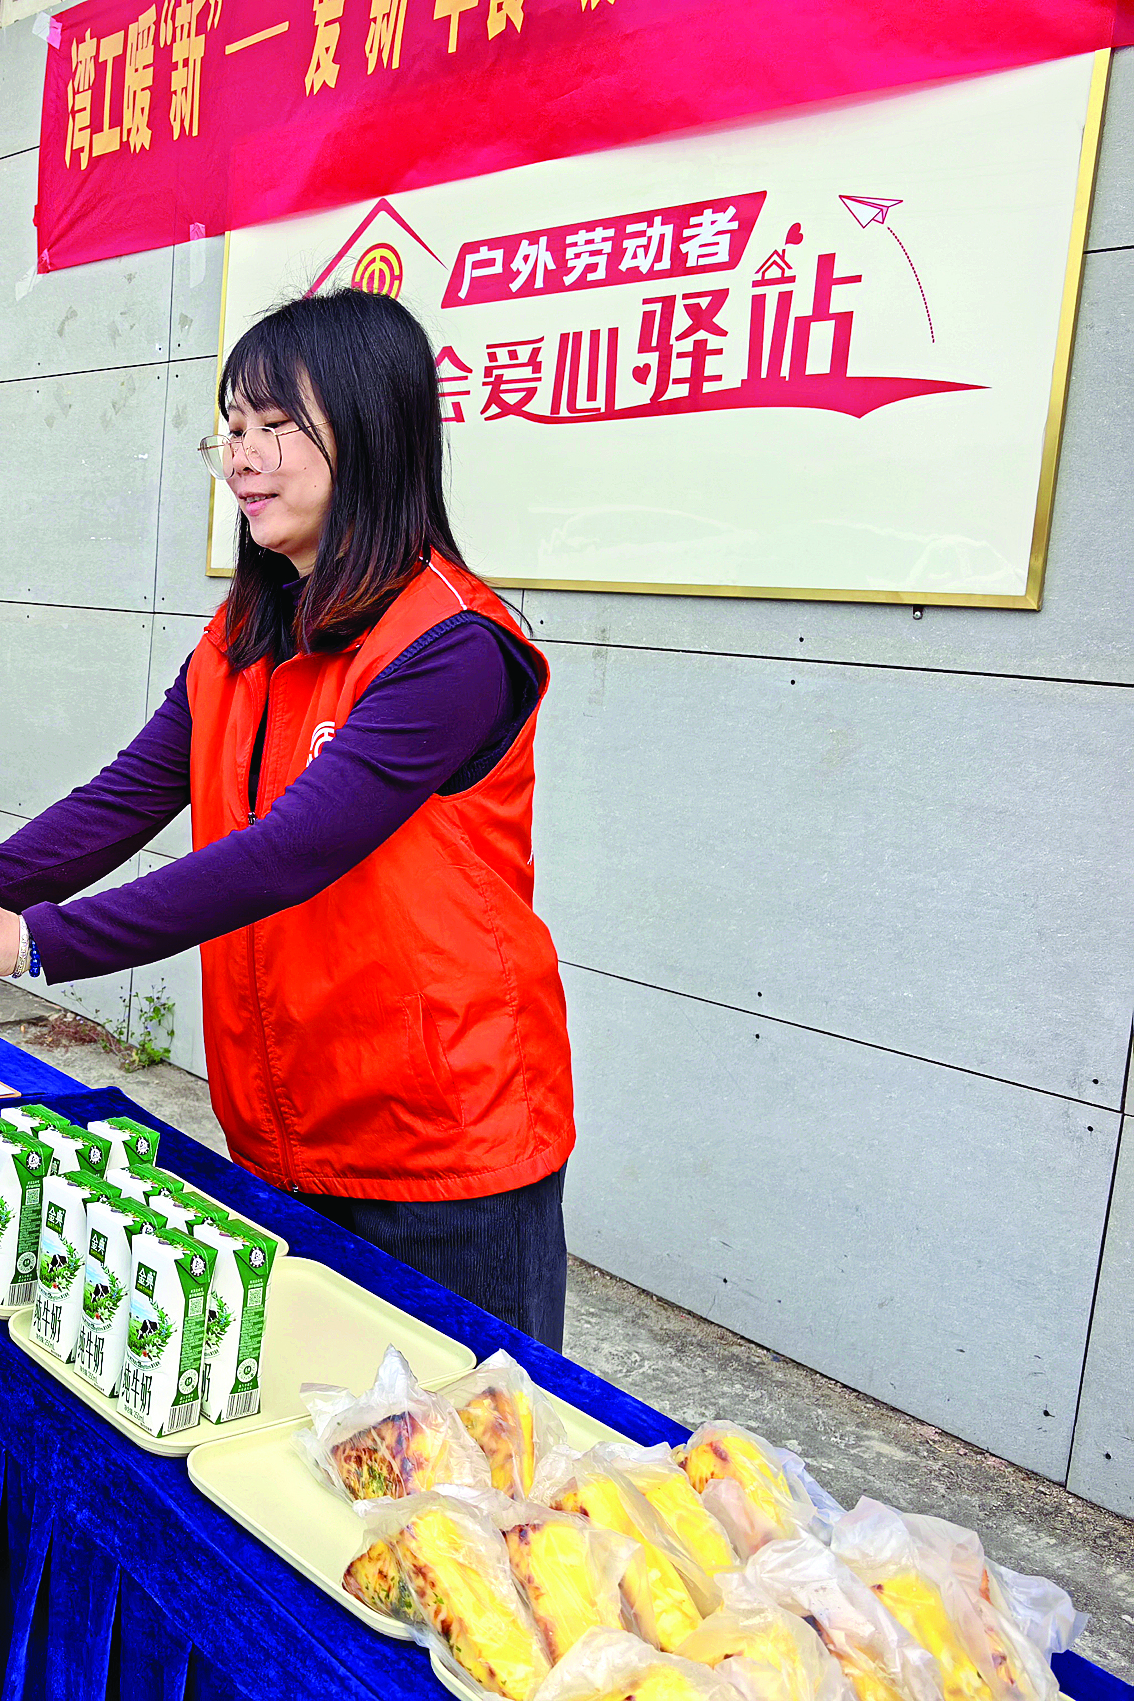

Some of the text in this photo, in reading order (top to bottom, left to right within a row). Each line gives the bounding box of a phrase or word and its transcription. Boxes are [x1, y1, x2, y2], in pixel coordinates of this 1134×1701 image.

[458, 205, 740, 300] 户外劳动者
[48, 1206, 65, 1227] 金典
[90, 1235, 107, 1256] 金典
[138, 1267, 156, 1290] 金典
[33, 1294, 62, 1343] 纯牛奶
[78, 1325, 105, 1376] 纯牛奶
[122, 1363, 153, 1416] 纯牛奶
